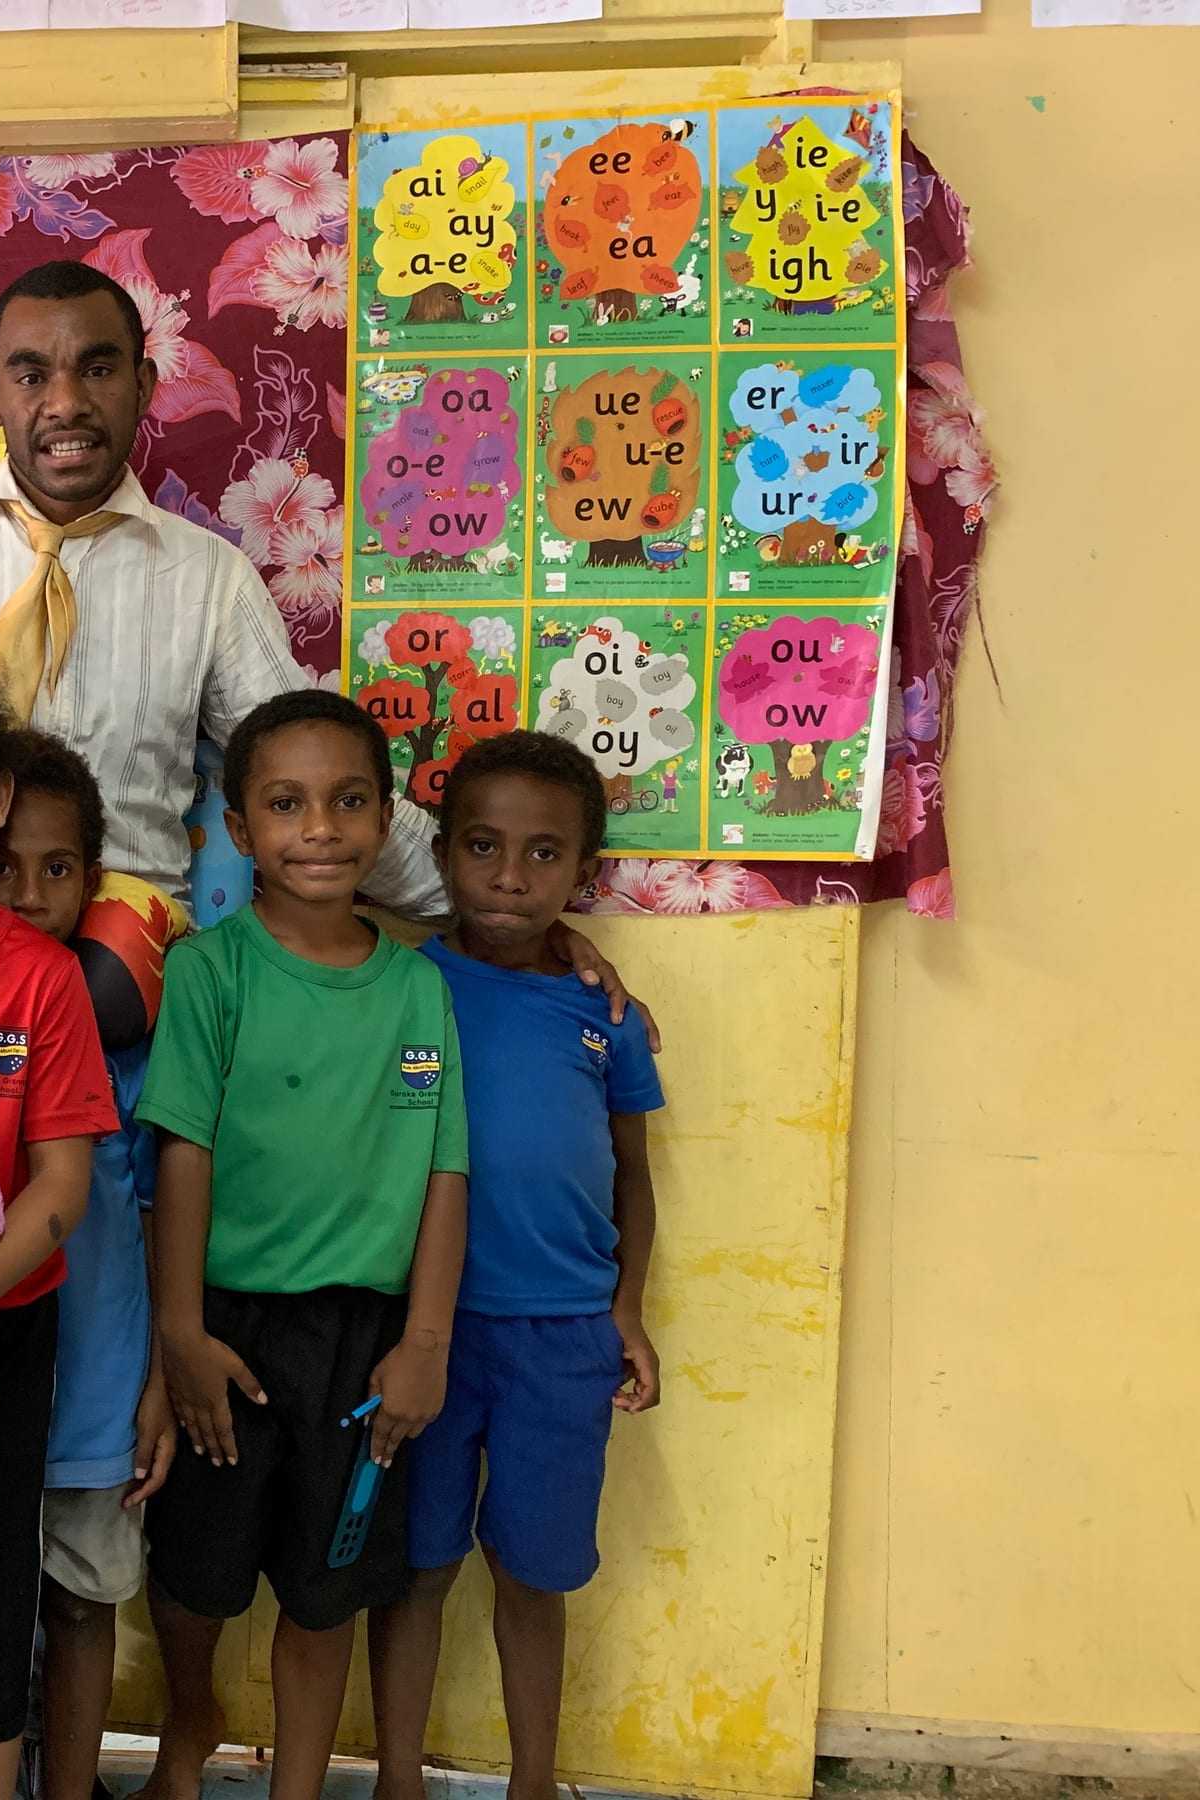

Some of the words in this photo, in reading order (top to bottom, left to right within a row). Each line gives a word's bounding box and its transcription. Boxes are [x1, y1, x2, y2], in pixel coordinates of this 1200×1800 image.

[589, 151, 631, 175] ee
[796, 136, 829, 168] ie
[410, 169, 445, 197] ai
[465, 177, 488, 195] snail
[755, 189, 776, 222] y
[816, 193, 860, 222] i-e
[403, 220, 421, 233] day
[450, 214, 494, 247] ay
[609, 236, 657, 260] ea
[411, 251, 467, 275] a-e
[769, 246, 833, 294] igh
[854, 261, 872, 275] pie
[650, 272, 674, 289] sheep
[441, 388, 492, 413] oa
[595, 391, 641, 416] ue
[747, 385, 784, 409] er
[656, 405, 684, 425] rescue
[570, 452, 590, 468] few
[626, 441, 685, 466] u-e
[841, 433, 869, 465] ir
[387, 454, 445, 479] o-e
[473, 455, 501, 470] grow
[392, 491, 414, 511] mole
[575, 497, 632, 521] ew
[649, 501, 674, 513] cube
[762, 491, 803, 516] ur
[837, 493, 854, 509] bird
[429, 512, 488, 537] ow
[408, 629, 449, 652] or
[771, 639, 823, 663] ou
[585, 643, 622, 675] oi
[653, 671, 671, 683] toy
[367, 695, 416, 720] au
[467, 688, 504, 722] al
[606, 694, 623, 709] boy
[766, 705, 827, 727] ow
[592, 730, 638, 768] oy
[405, 1050, 438, 1061] G.G.S
